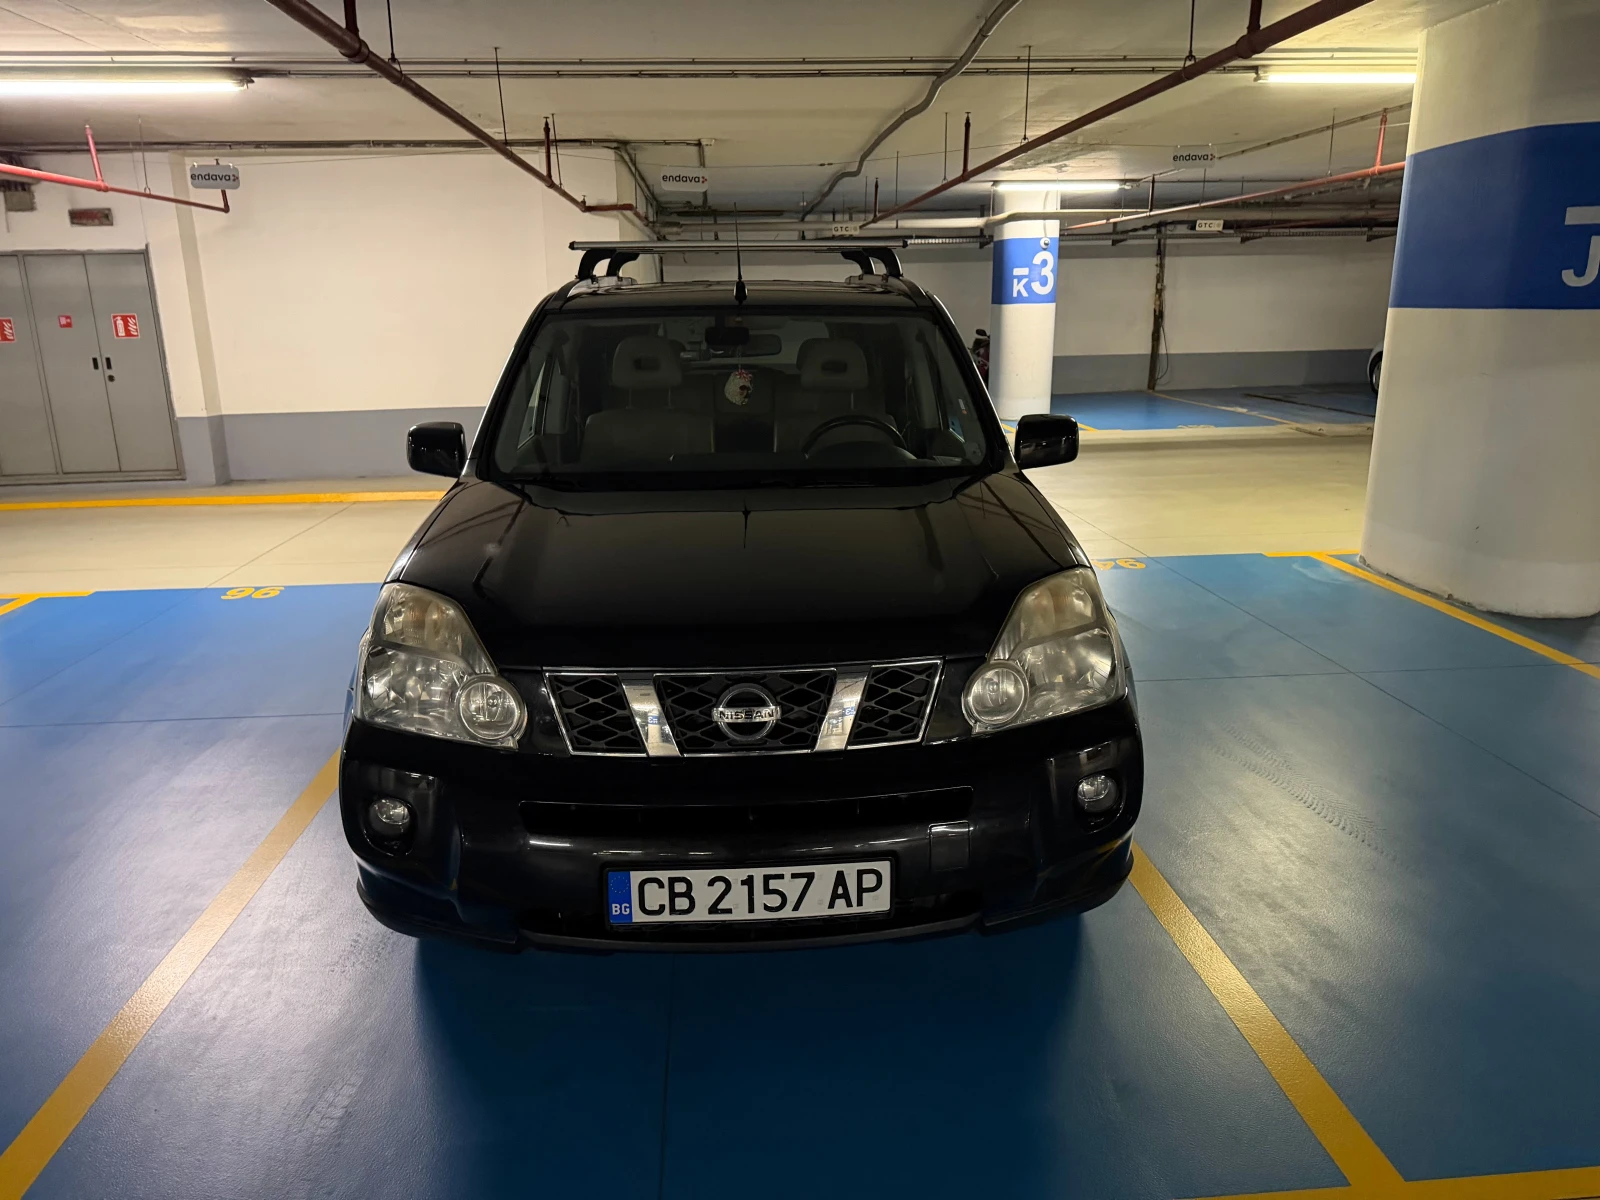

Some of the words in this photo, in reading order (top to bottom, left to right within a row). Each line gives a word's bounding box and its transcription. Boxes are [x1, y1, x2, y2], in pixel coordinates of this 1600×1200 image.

[1172, 153, 1209, 162] endava
[190, 172, 231, 182] endava
[661, 173, 701, 184] endava
[220, 586, 285, 600] 96
[718, 709, 774, 720] NISSAN
[637, 876, 696, 917] CB
[707, 871, 816, 916] 2157
[827, 868, 884, 910] AP
[611, 903, 630, 915] BG
